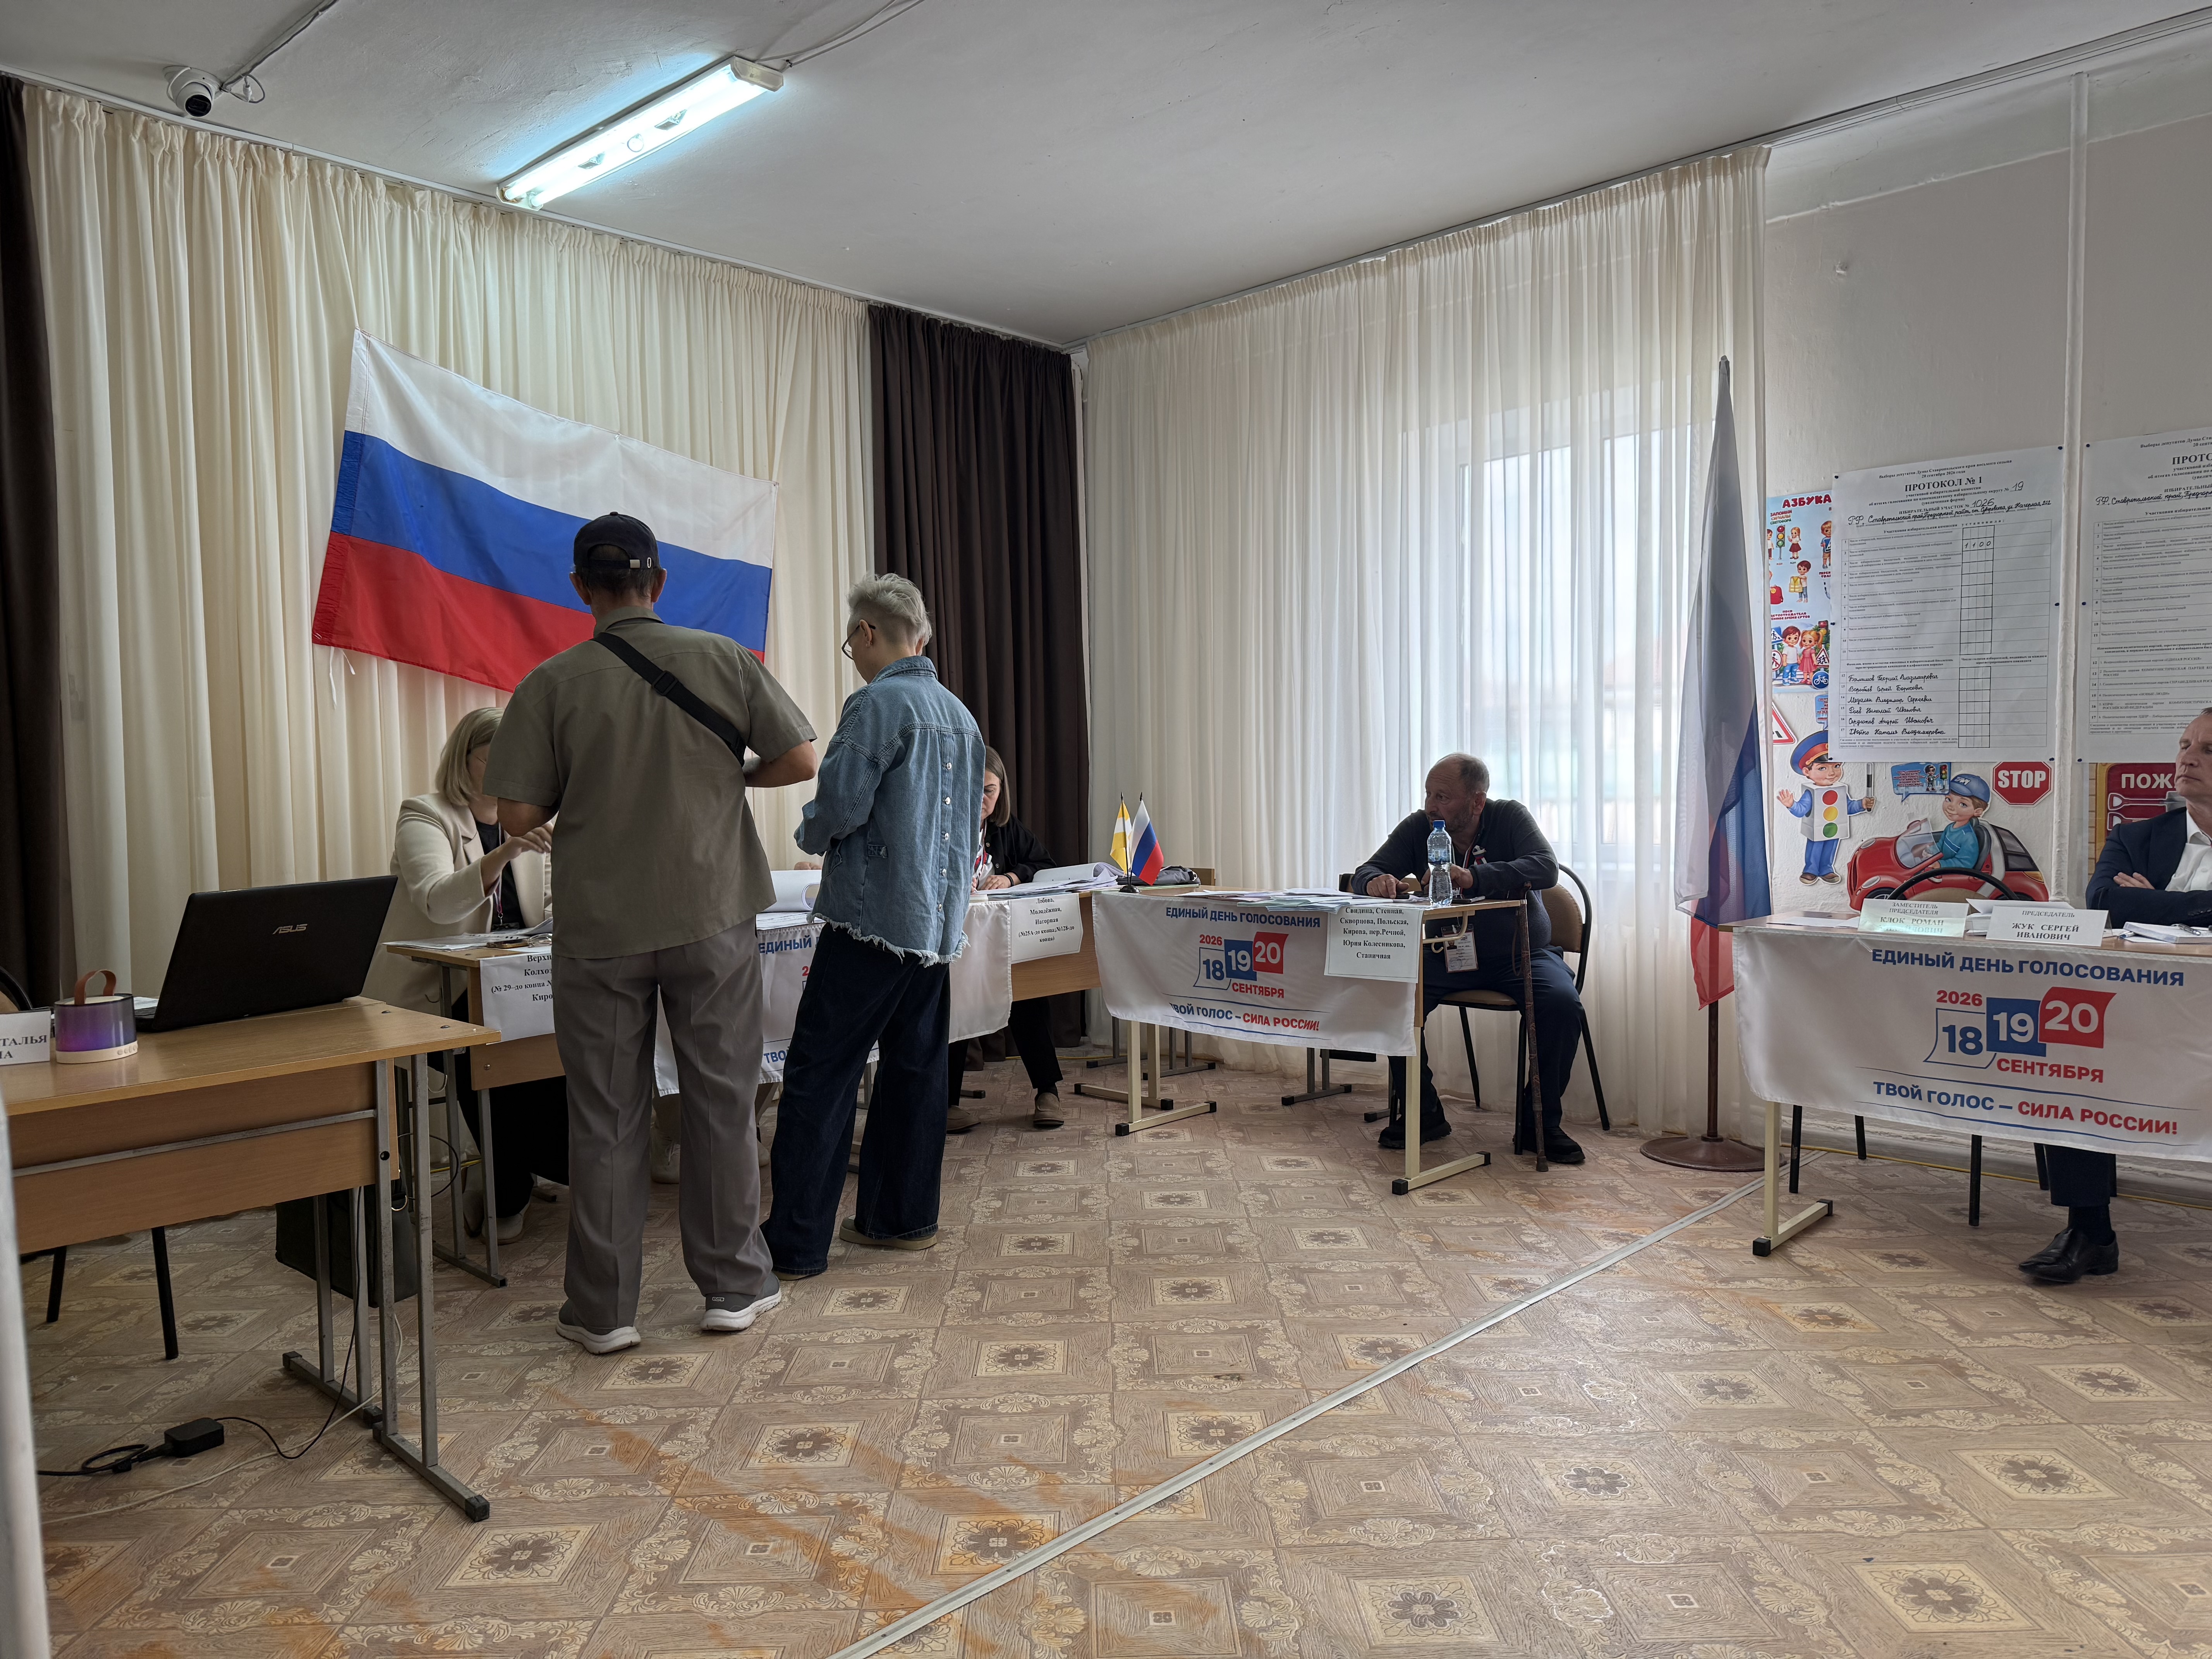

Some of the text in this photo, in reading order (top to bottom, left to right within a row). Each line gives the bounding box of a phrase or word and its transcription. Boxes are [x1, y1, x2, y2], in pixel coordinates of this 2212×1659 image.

[1905, 478, 1962, 491] ПРОТОКОЛ
[2012, 481, 2024, 491] 19
[1782, 494, 1831, 508] АЗБУКА
[1972, 498, 1994, 508] 1026
[1998, 770, 2046, 788] STOP
[2121, 773, 2176, 789] ПОЖ
[1166, 907, 1321, 927] ЕДИНЫЙ ДЕНЬ ГОЛОСОВАНИЯ
[1340, 917, 1375, 926] Скворцова,
[272, 924, 308, 935] ASUS
[2016, 932, 2071, 940] ИВАНОВИЧ
[2041, 924, 2079, 932] СЕРГЕЙ
[758, 935, 812, 955] ЕДИНЫЙ
[1199, 934, 1223, 946] 2026
[1343, 939, 1405, 948] Юрия Колесникова,
[1202, 941, 1281, 981] 18 19 20
[1872, 949, 2184, 986] ЕДИНЫЙ ДЕНЬ ГОЛОСОВАНИЯ
[1231, 982, 1285, 999] СЕНТЯБРЯ
[1936, 990, 1983, 1006] 2026
[1196, 1006, 1233, 1020] ГОЛОС
[1243, 1013, 1271, 1026] СИЛА
[1273, 1017, 1320, 1031] РОССИИ!
[1942, 1000, 2099, 1055] 18 19 20
[763, 1046, 790, 1063] ТВО
[1996, 1058, 2104, 1083] СЕНТЯБРЯ
[1873, 1081, 1922, 1102] ТВОЙ
[1927, 1090, 1994, 1111] ГОЛОС
[2017, 1101, 2075, 1121] СИЛА
[2080, 1108, 2178, 1135] РОССИИ!
